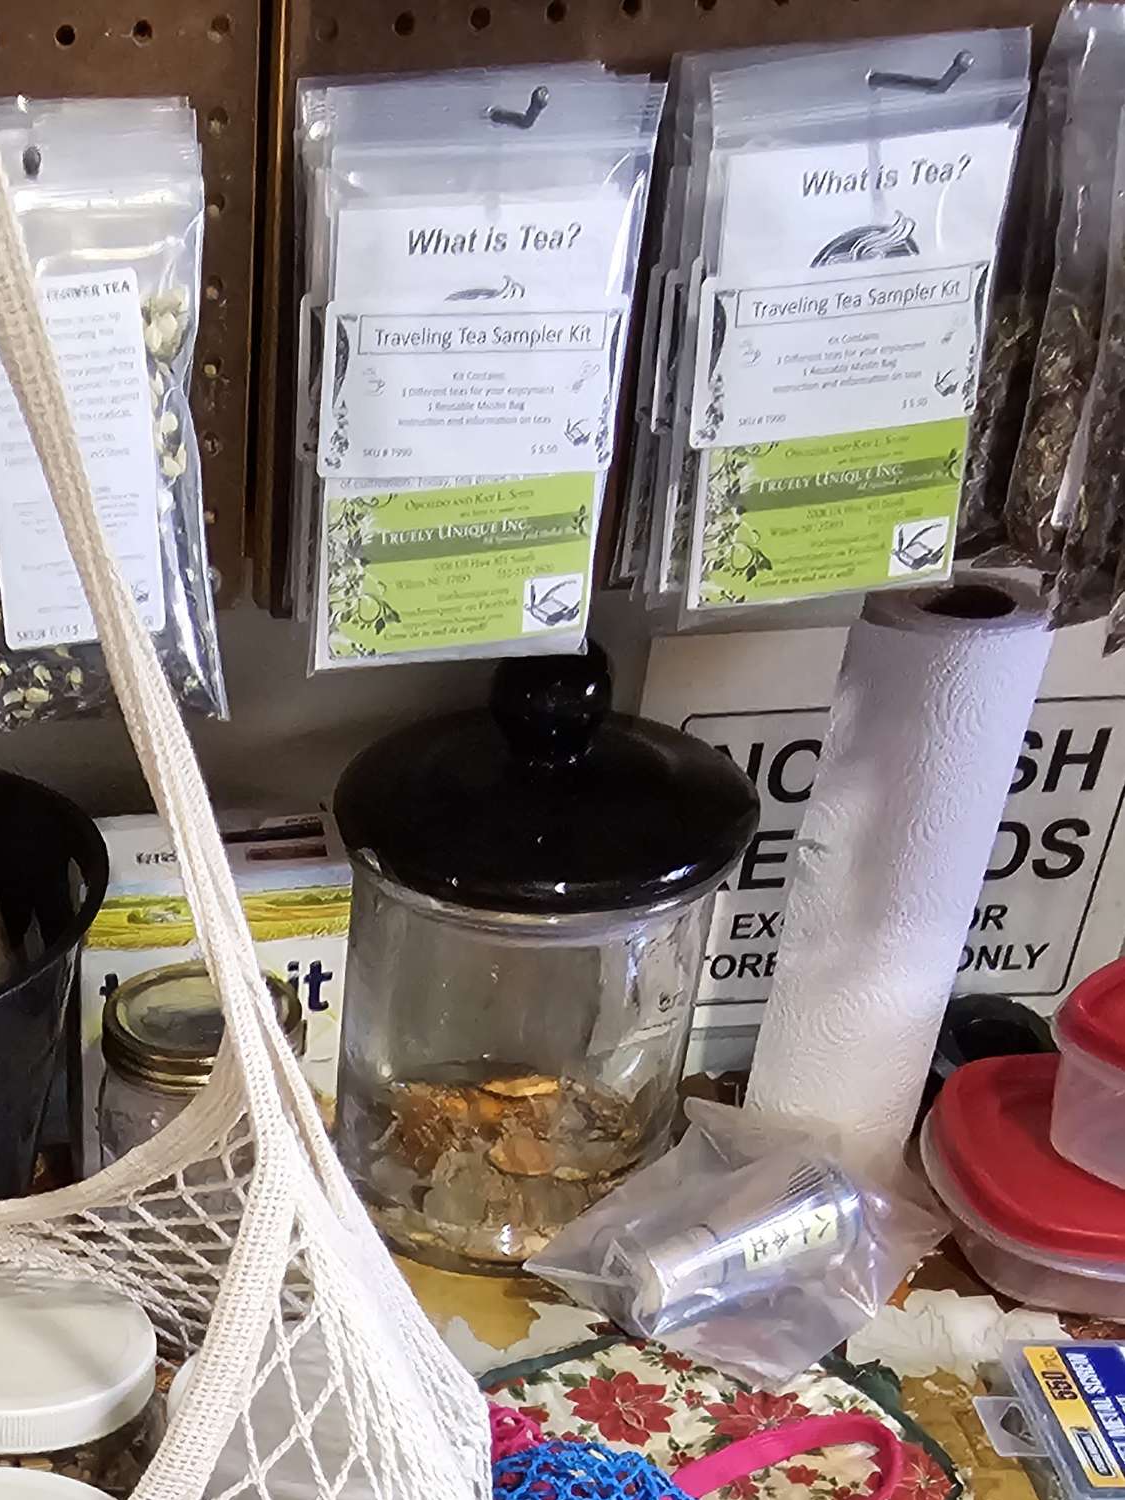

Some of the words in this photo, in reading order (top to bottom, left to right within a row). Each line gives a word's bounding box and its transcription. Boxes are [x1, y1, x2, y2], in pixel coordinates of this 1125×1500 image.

[802, 167, 868, 198] What
[874, 164, 899, 190] is
[911, 153, 972, 186] Tea?
[408, 227, 477, 256] What
[484, 225, 508, 252] is
[520, 221, 582, 251] Tea?
[103, 279, 130, 295] TEA
[752, 298, 829, 319] Traveling
[835, 292, 862, 310] Tea
[868, 283, 937, 306] Sampler
[941, 279, 961, 297] Kit
[374, 327, 453, 350] Traveling
[459, 325, 487, 345] Tea
[492, 319, 563, 349] Sampler
[569, 324, 592, 343] Kit
[380, 528, 434, 546] TRUELY
